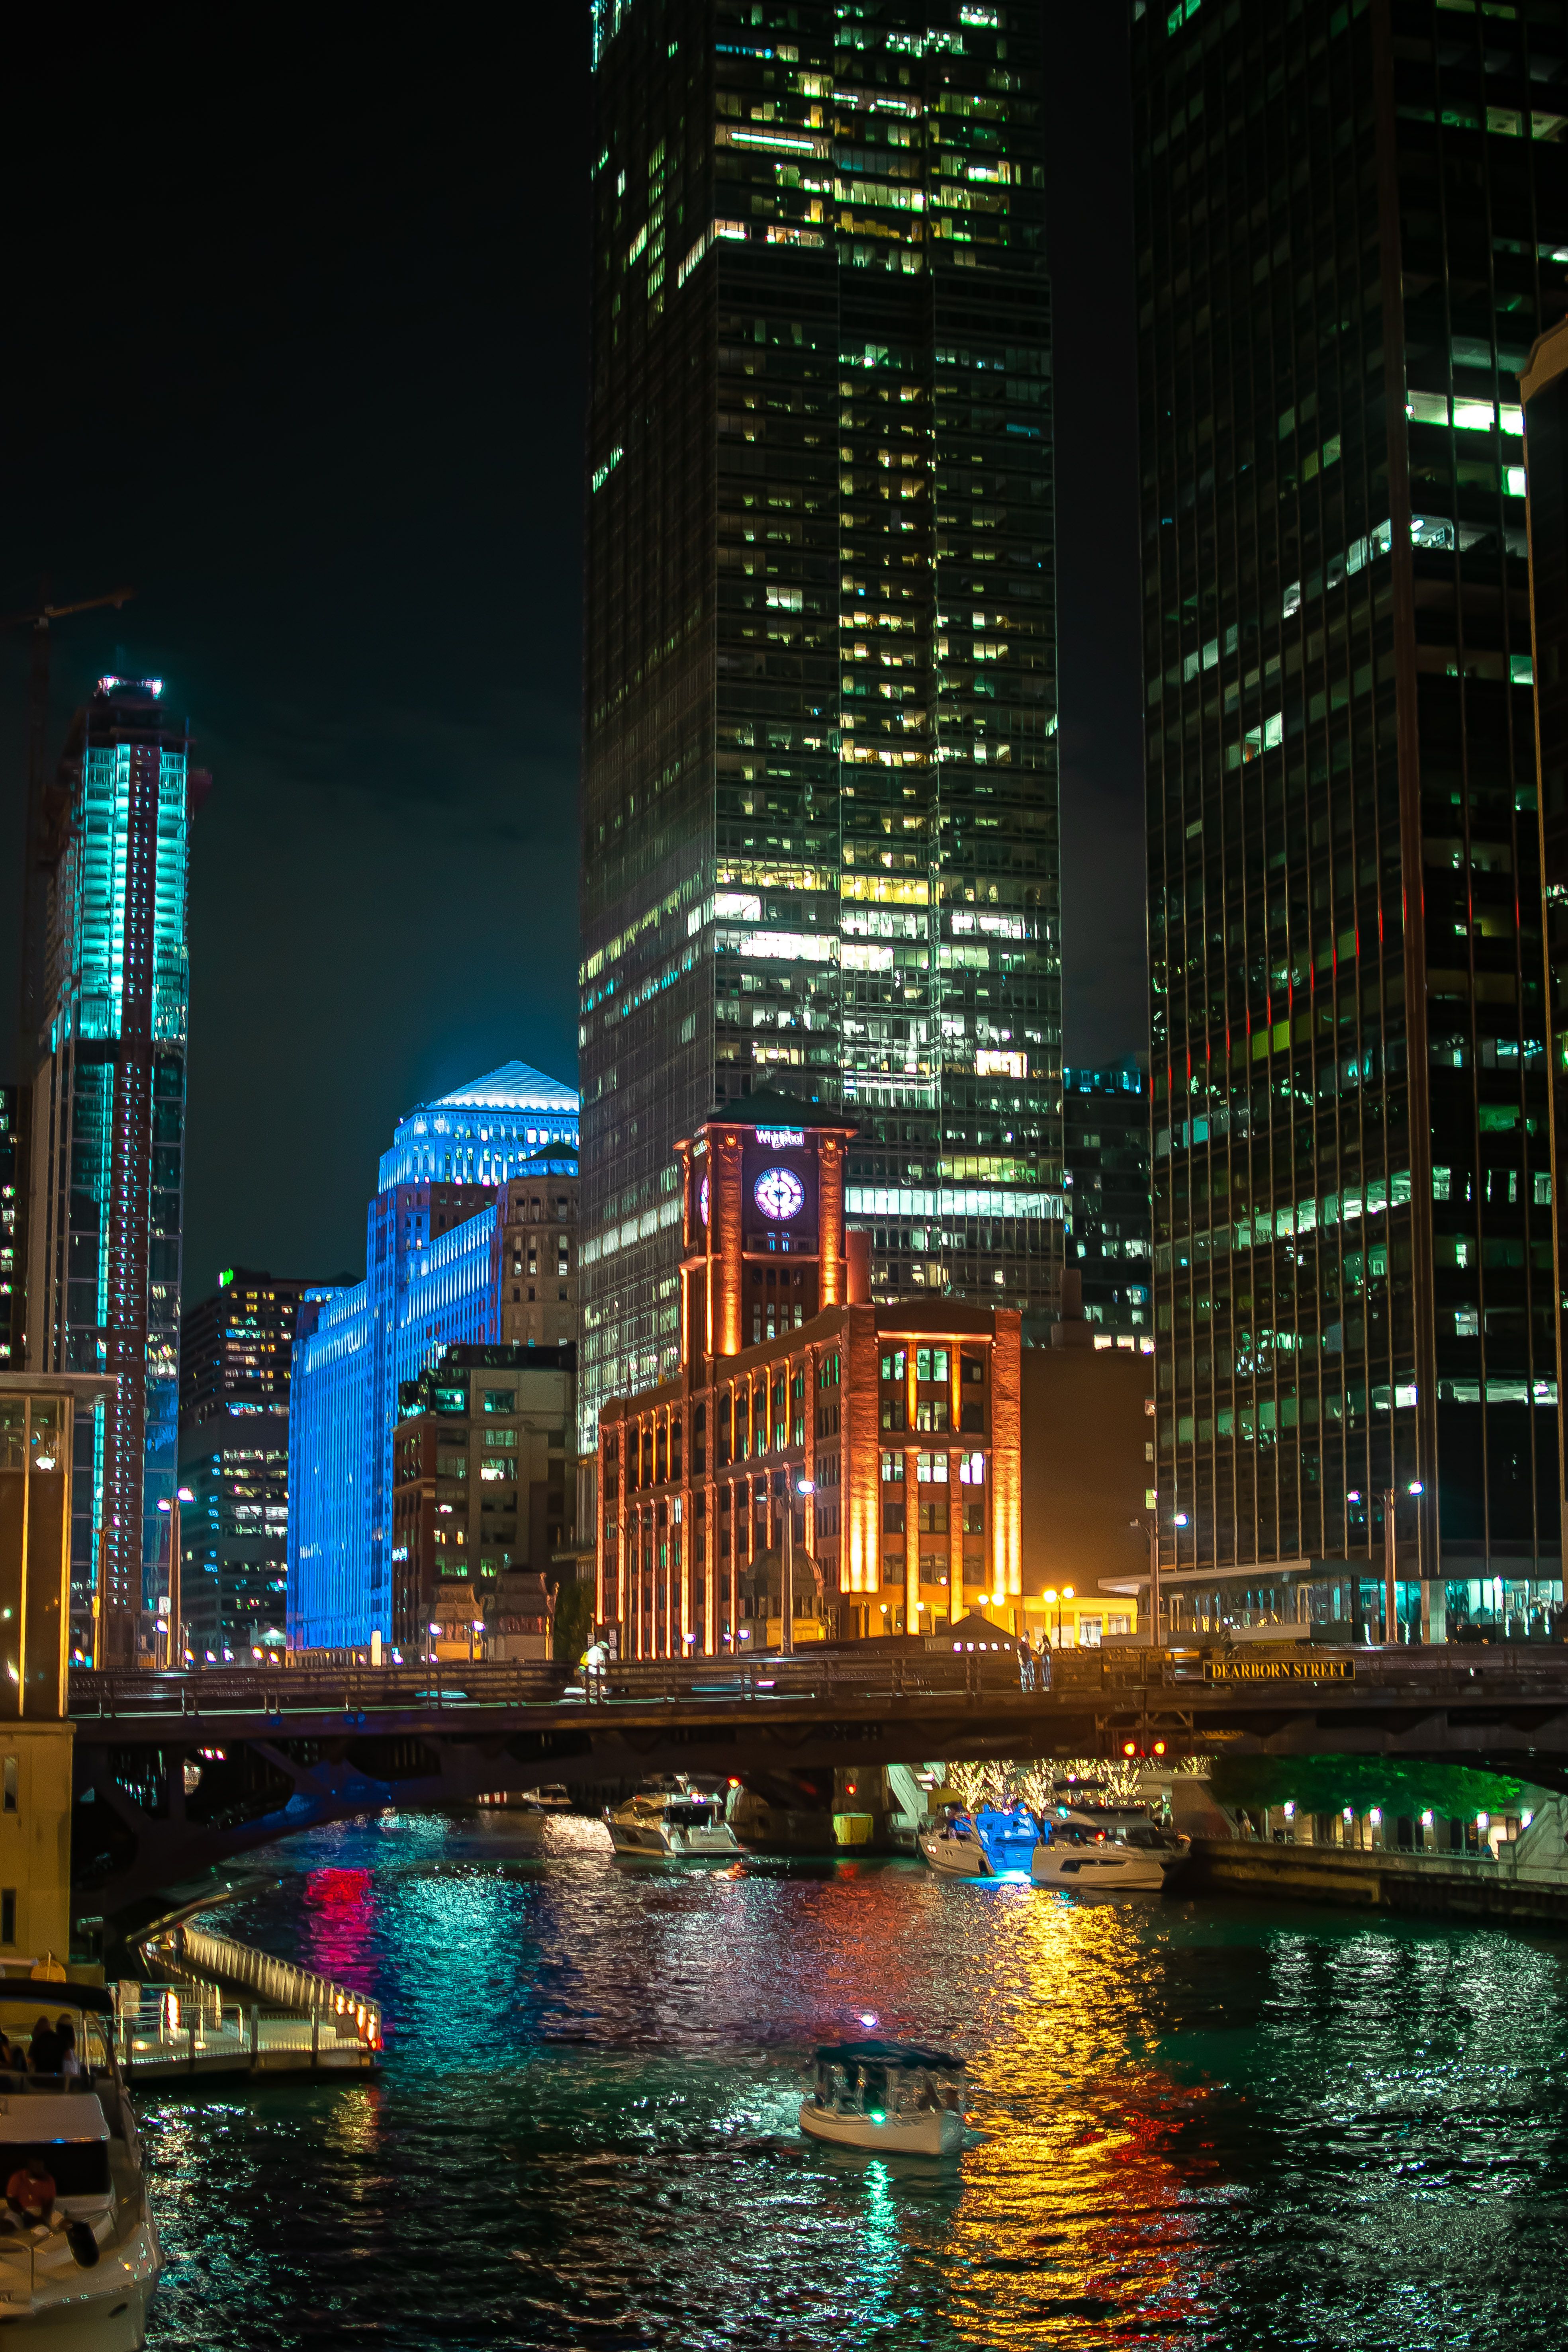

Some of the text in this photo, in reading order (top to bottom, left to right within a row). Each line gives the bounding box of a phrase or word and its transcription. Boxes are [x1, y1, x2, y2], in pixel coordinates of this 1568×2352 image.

[755, 1130, 804, 1149] Whirlpool
[1212, 1661, 1347, 1679] DEARBORN STREET
